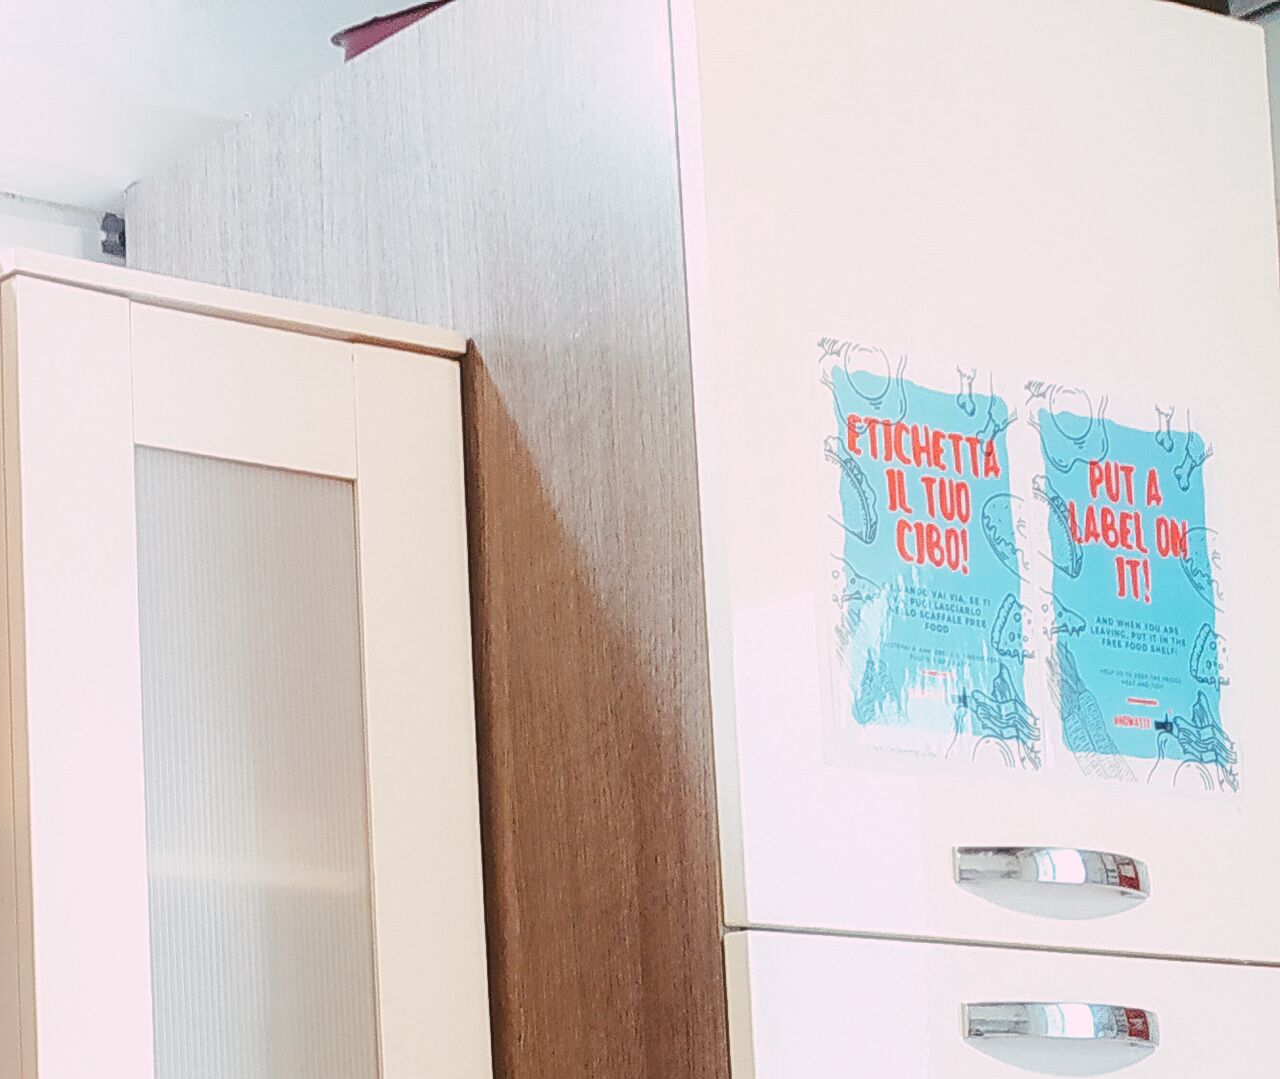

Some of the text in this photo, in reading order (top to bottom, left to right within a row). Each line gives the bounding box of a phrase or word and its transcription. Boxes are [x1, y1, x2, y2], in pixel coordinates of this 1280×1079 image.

[847, 413, 1001, 479] ETICHETTA
[886, 468, 971, 524] IL TUO
[1088, 459, 1163, 506] PUT A
[896, 518, 969, 575] CIBO!
[1068, 500, 1188, 560] LABEL ON
[1115, 556, 1151, 604] IT!
[1096, 615, 1114, 626] AND
[1116, 618, 1141, 630] WHEN
[1144, 623, 1160, 633] YOU
